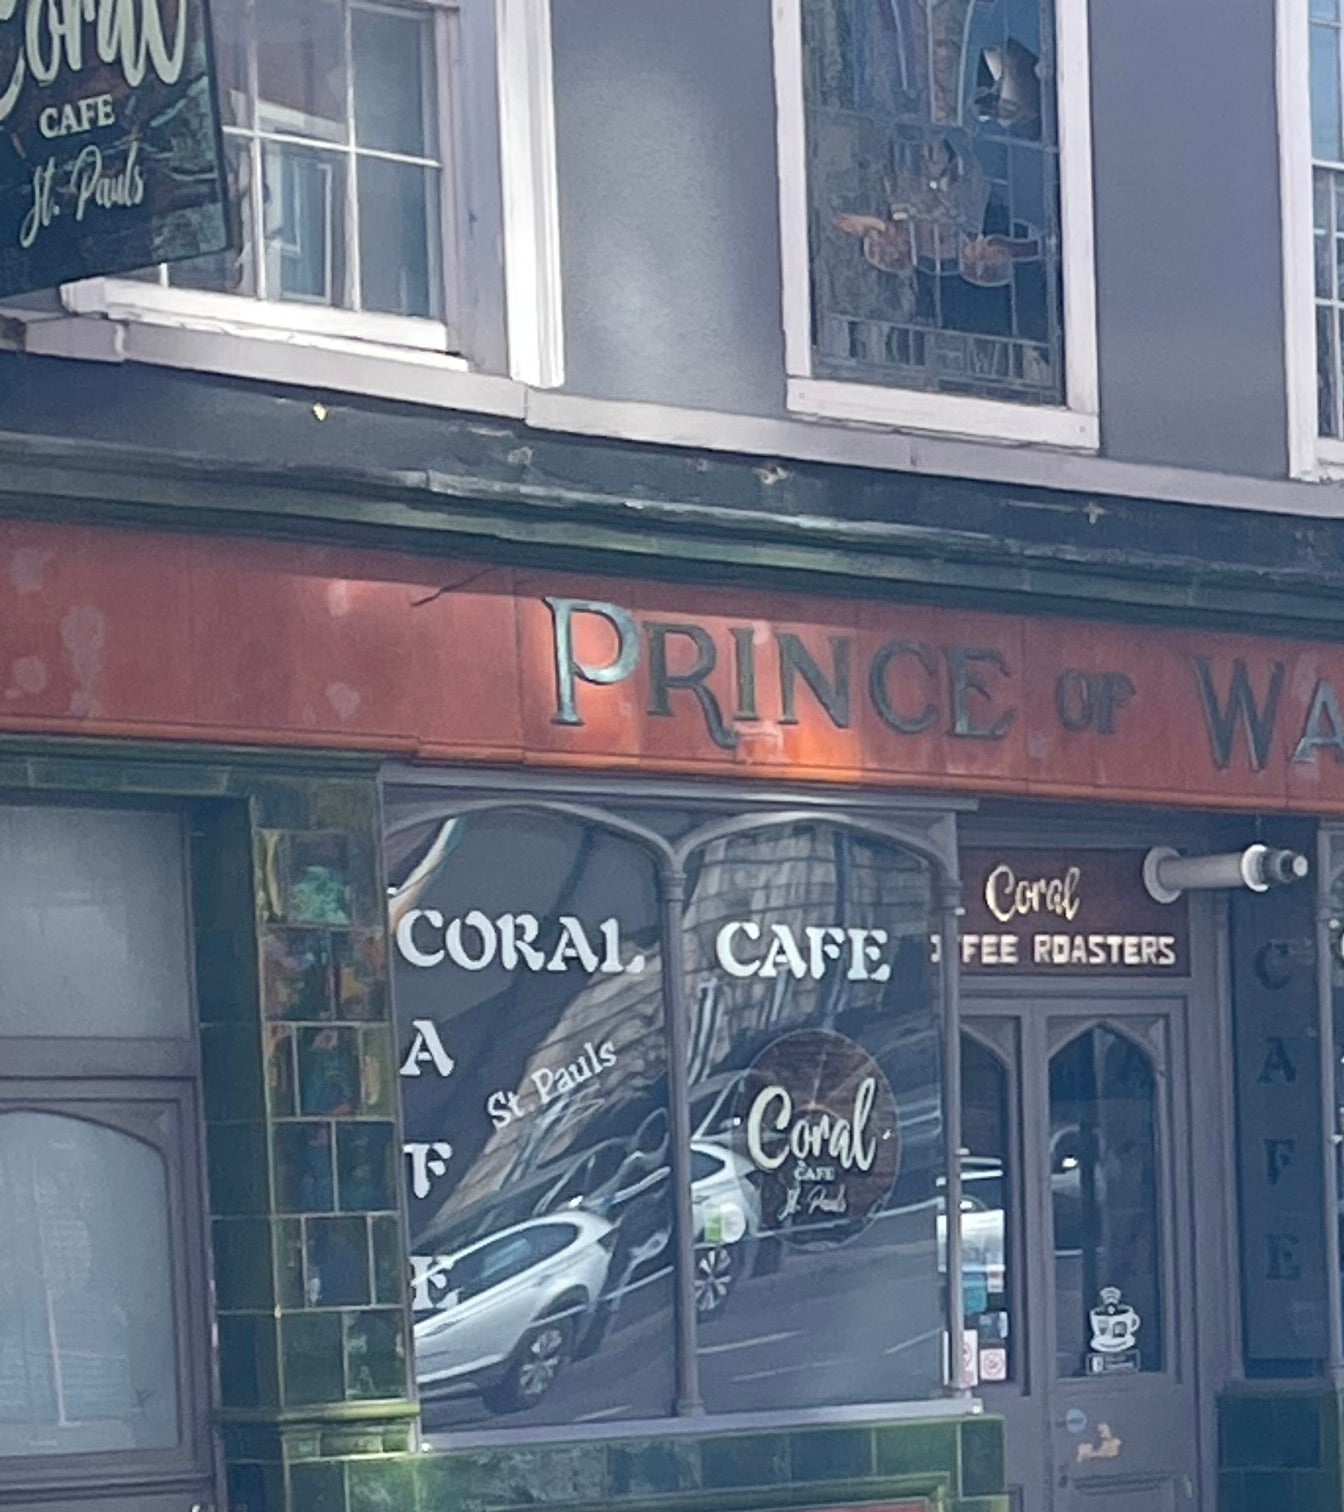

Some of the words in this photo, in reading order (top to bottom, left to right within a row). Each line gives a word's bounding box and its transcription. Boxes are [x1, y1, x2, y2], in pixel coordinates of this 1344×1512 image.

[40, 94, 115, 138] CAFE
[543, 596, 1013, 750] PRINCE
[1056, 667, 1138, 736] OF
[986, 865, 1081, 921] Coral
[397, 909, 645, 974] CORAL
[715, 920, 890, 983] CAFE
[1034, 935, 1176, 966] ROASTERS
[530, 1037, 619, 1104] Pauls
[746, 1076, 878, 1172] Coral
